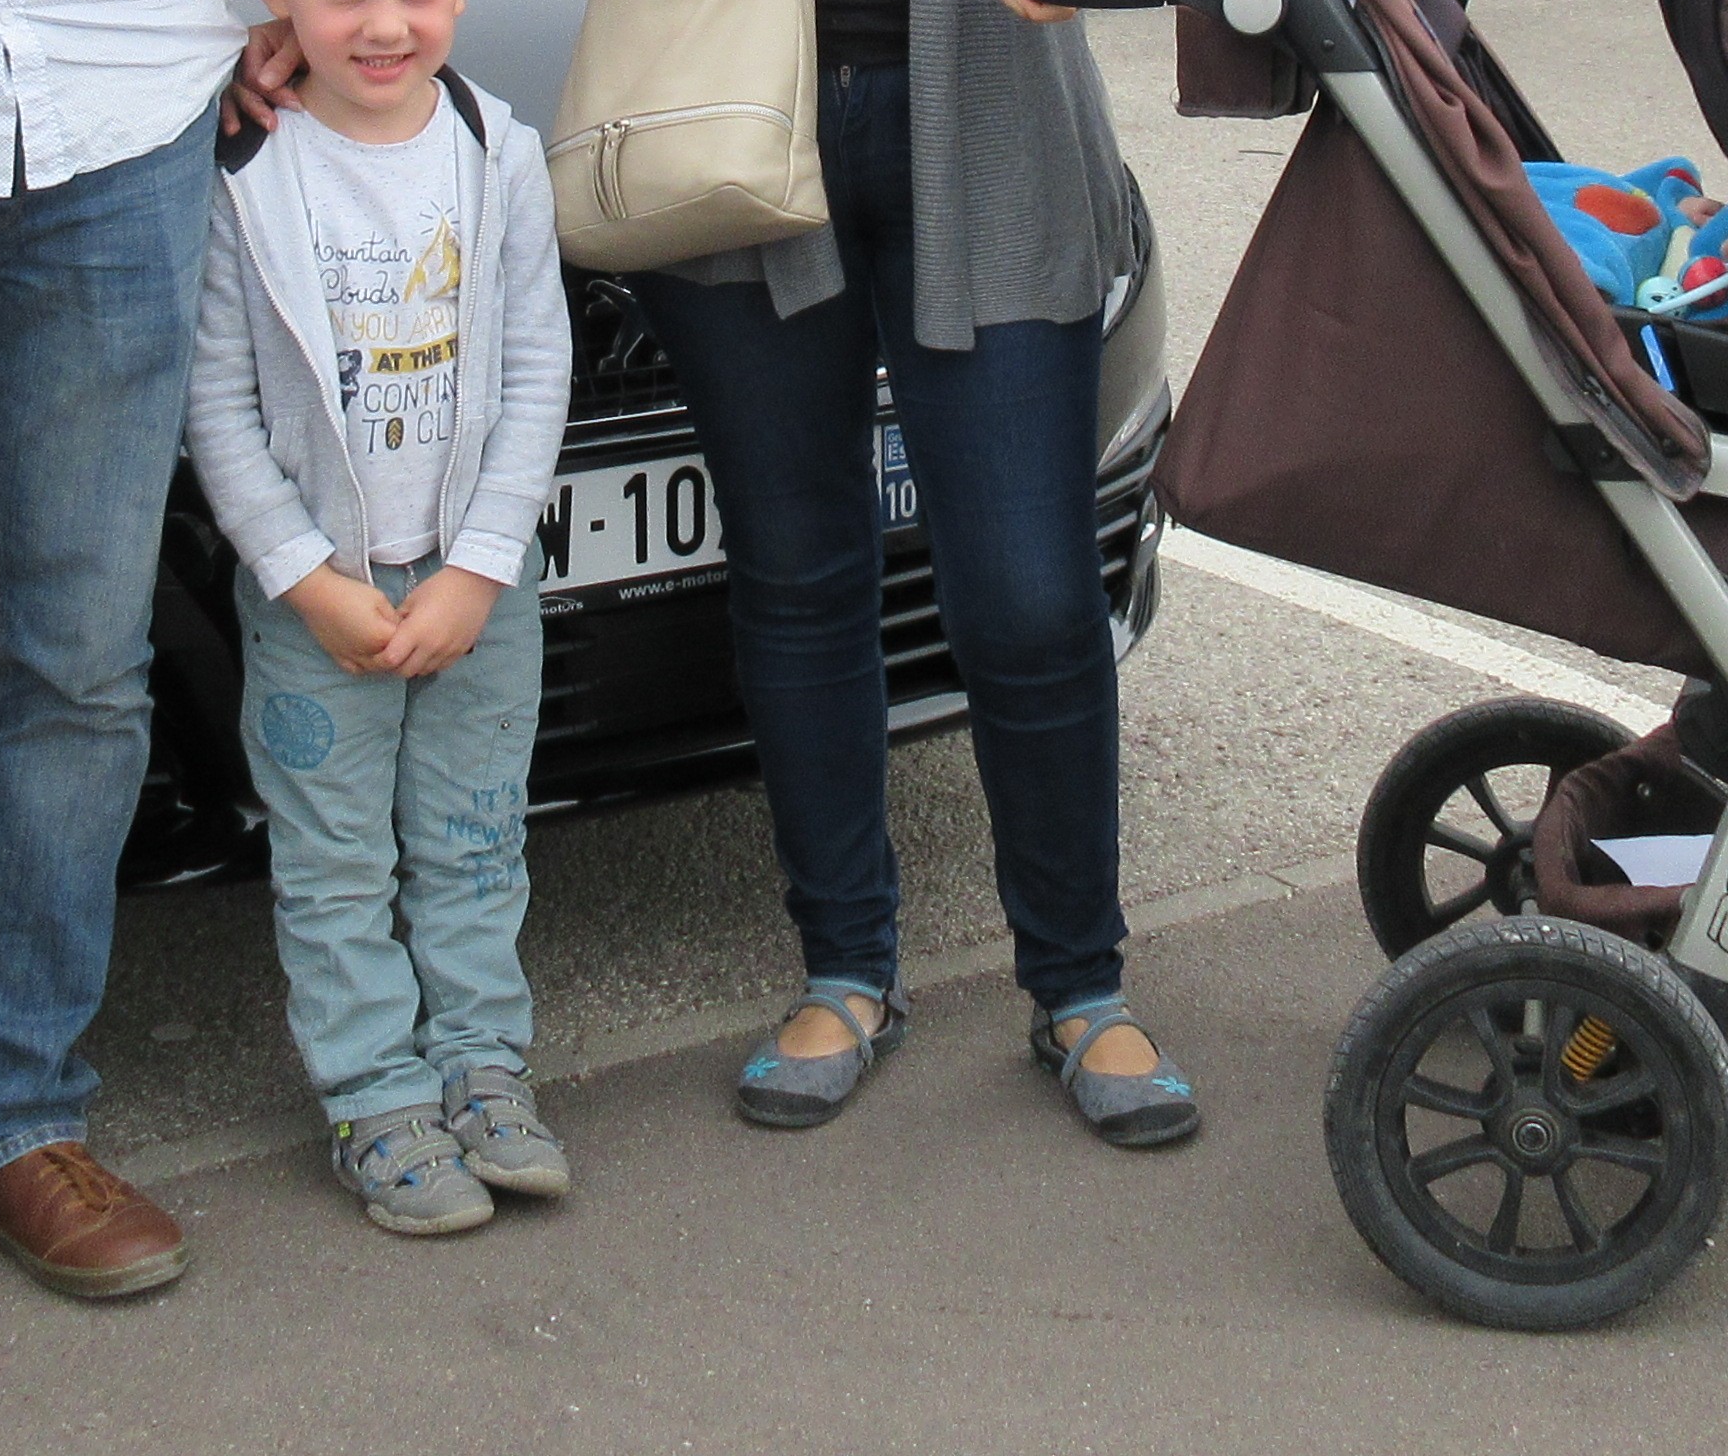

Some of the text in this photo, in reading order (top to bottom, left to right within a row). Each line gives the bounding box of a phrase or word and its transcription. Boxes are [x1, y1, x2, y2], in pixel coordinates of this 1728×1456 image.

[320, 264, 399, 305] Clouds
[352, 311, 399, 342] YOU
[376, 353, 403, 372] AT
[410, 344, 442, 369] THE
[886, 479, 917, 521] 10
